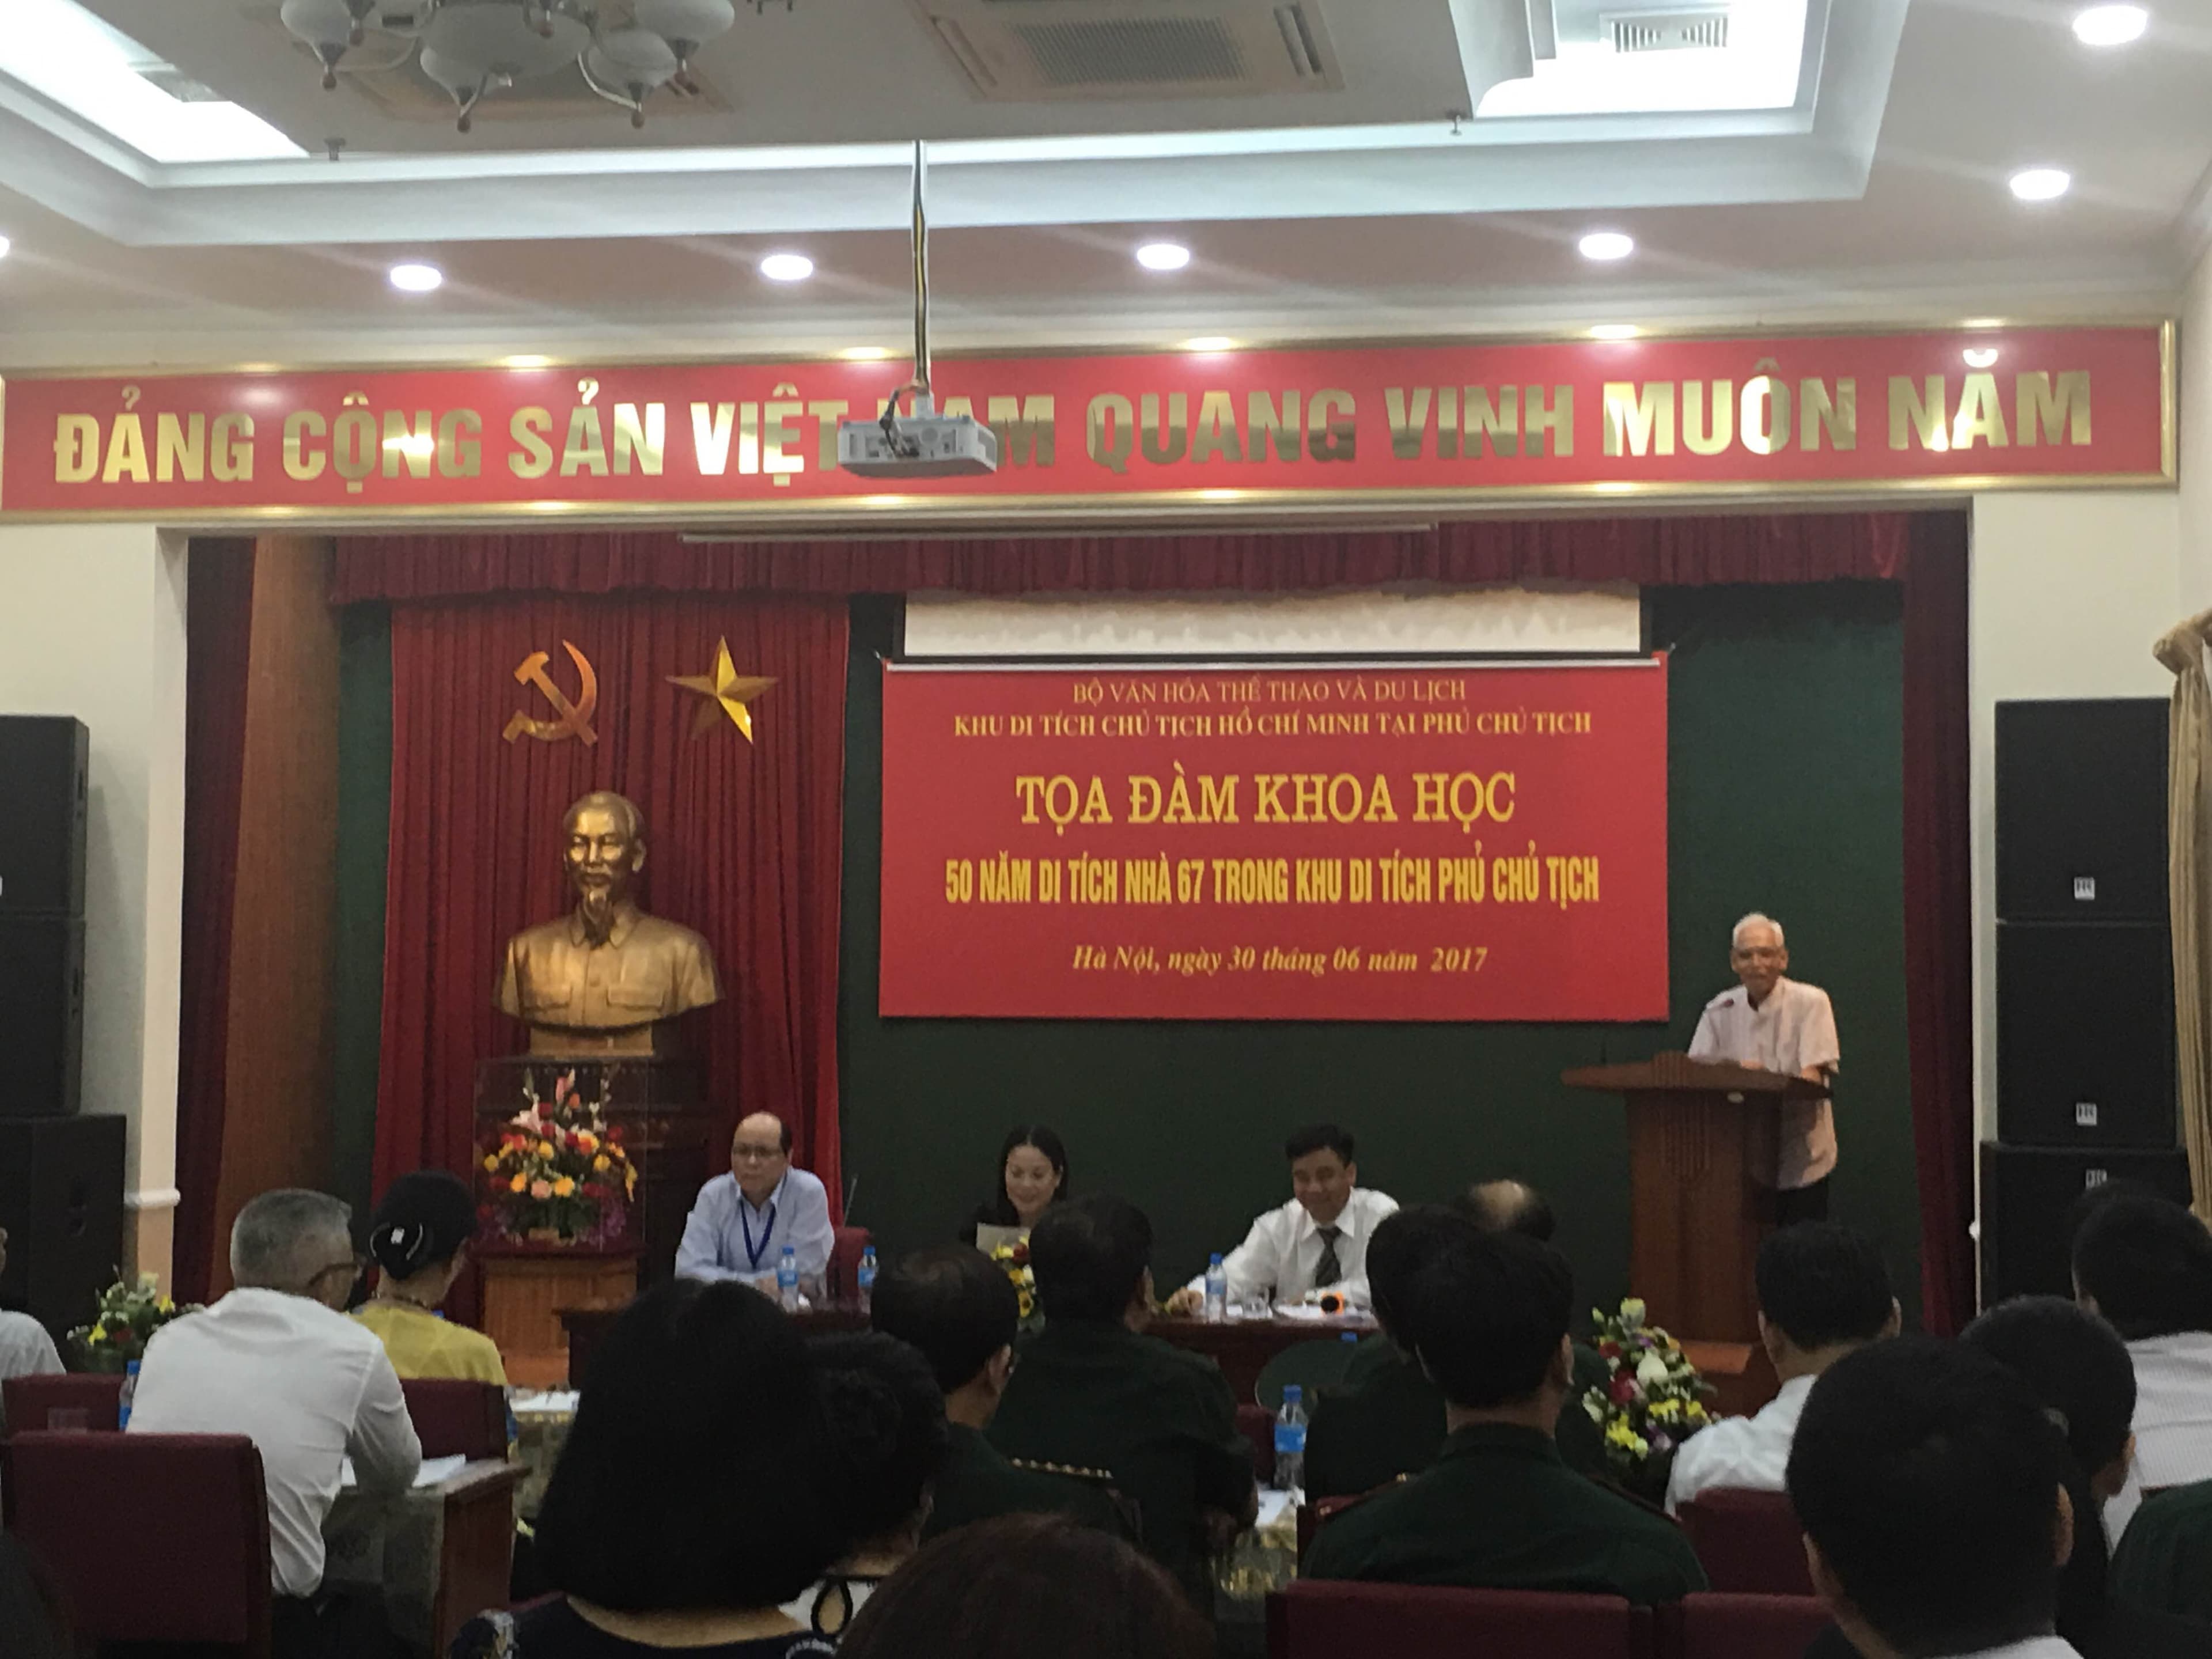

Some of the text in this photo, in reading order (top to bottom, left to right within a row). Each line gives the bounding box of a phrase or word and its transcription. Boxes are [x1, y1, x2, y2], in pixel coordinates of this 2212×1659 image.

[54, 385, 255, 483] ĐẢNG
[283, 392, 482, 493] CỘNG
[508, 377, 665, 479] SẢN
[691, 382, 849, 486] VIỆT
[1086, 388, 1356, 474] QUANG
[1384, 385, 1574, 459] VINH
[1603, 358, 1857, 456] MUÔN
[1888, 347, 2092, 452] NĂM
[1074, 676, 1103, 707] BỘ
[1110, 679, 1156, 703] VĂN
[1267, 680, 1330, 702] THAO
[1336, 674, 1367, 701] VÀ
[1375, 680, 1406, 702] DU
[1413, 679, 1465, 704] LỊCH
[954, 715, 1003, 737] KHU
[1010, 715, 1033, 737] DI
[1039, 710, 1095, 737] TÍCH
[1101, 709, 1150, 737] CHỦ
[1155, 714, 1211, 739] TỊCH
[1257, 709, 1300, 736] CHÍ
[1306, 713, 1369, 735] MINH
[1376, 713, 1415, 737] TẠI
[1423, 706, 1469, 734] PHỦ
[1476, 706, 1527, 734] CHỦ
[1532, 712, 1592, 736] TỊCH
[1016, 760, 1515, 835] TỌA ĐÀM KHOA HỌC
[945, 839, 1599, 910] 50 NĂM DI TÍCH NHÀ 67 TRONG KHU DI TÍCH PHỦ CHỦ TỊCH
[1073, 945, 1107, 969] Hà
[1168, 946, 1221, 976] ngày
[1228, 945, 1255, 971] 30
[1262, 945, 1327, 977] tháng
[1333, 945, 1361, 972] 06
[1368, 949, 1418, 972] năm
[1430, 946, 1488, 972] 2017
